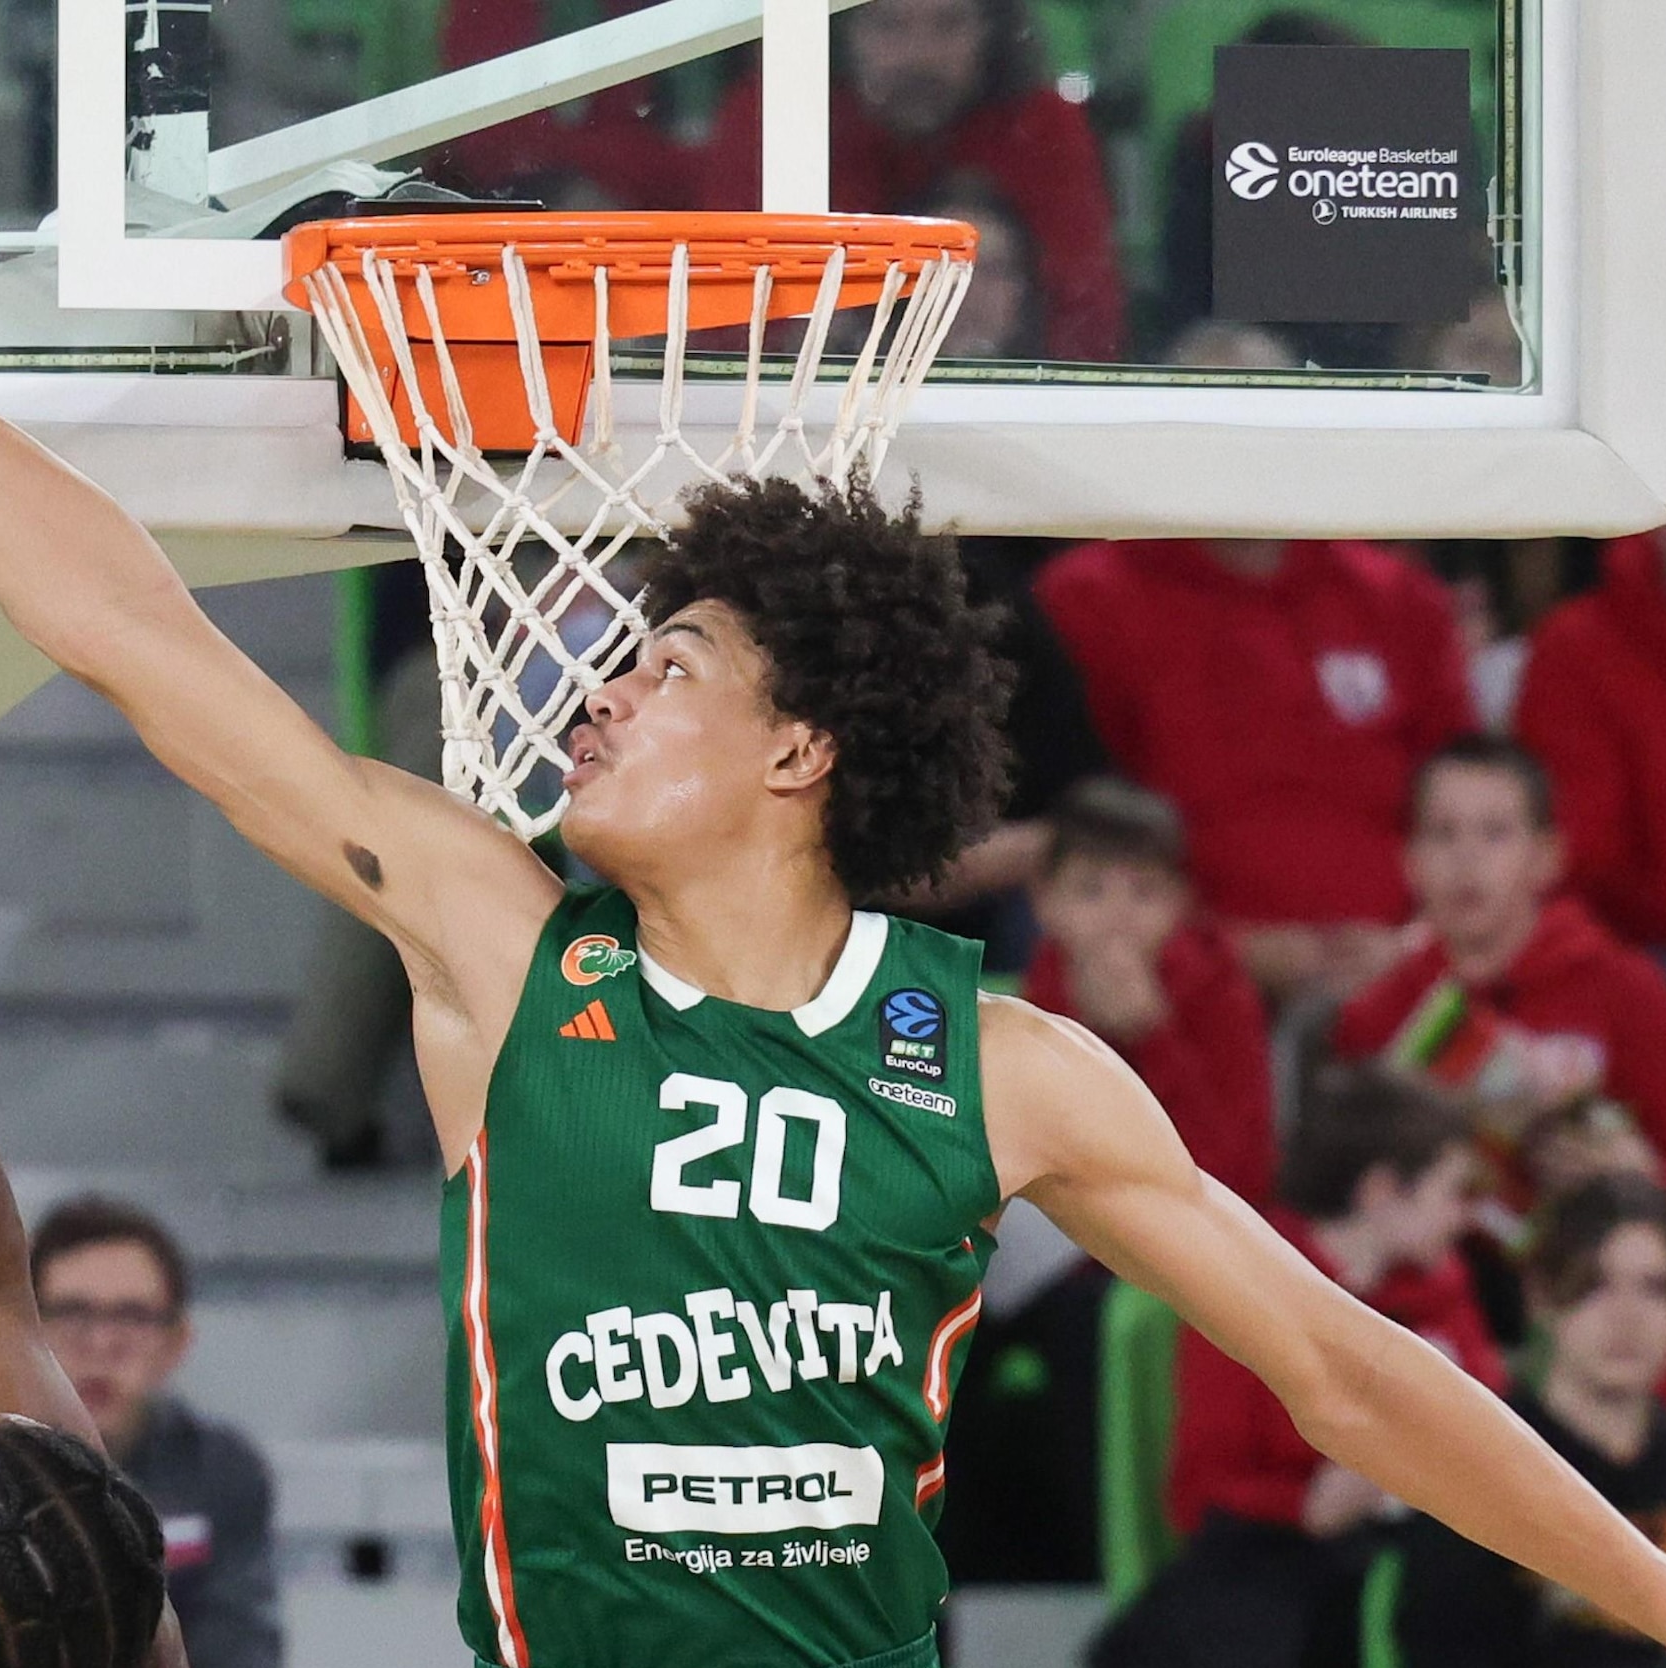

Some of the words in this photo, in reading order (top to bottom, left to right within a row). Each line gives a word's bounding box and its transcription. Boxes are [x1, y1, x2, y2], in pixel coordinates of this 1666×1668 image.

[1287, 146, 1377, 167] Euroleague
[1379, 147, 1457, 164] Basketball
[1287, 164, 1458, 199] oneteam
[1341, 205, 1397, 219] TURKISH
[1399, 207, 1458, 220] AIRLINES
[885, 1054, 942, 1077] EuroCup
[869, 1078, 956, 1117] oneteam
[650, 1072, 847, 1232] 20
[545, 1287, 904, 1422] CEDEVITA
[643, 1470, 853, 1505] PETROL
[624, 1538, 733, 1574] Energija
[740, 1549, 775, 1568] za
